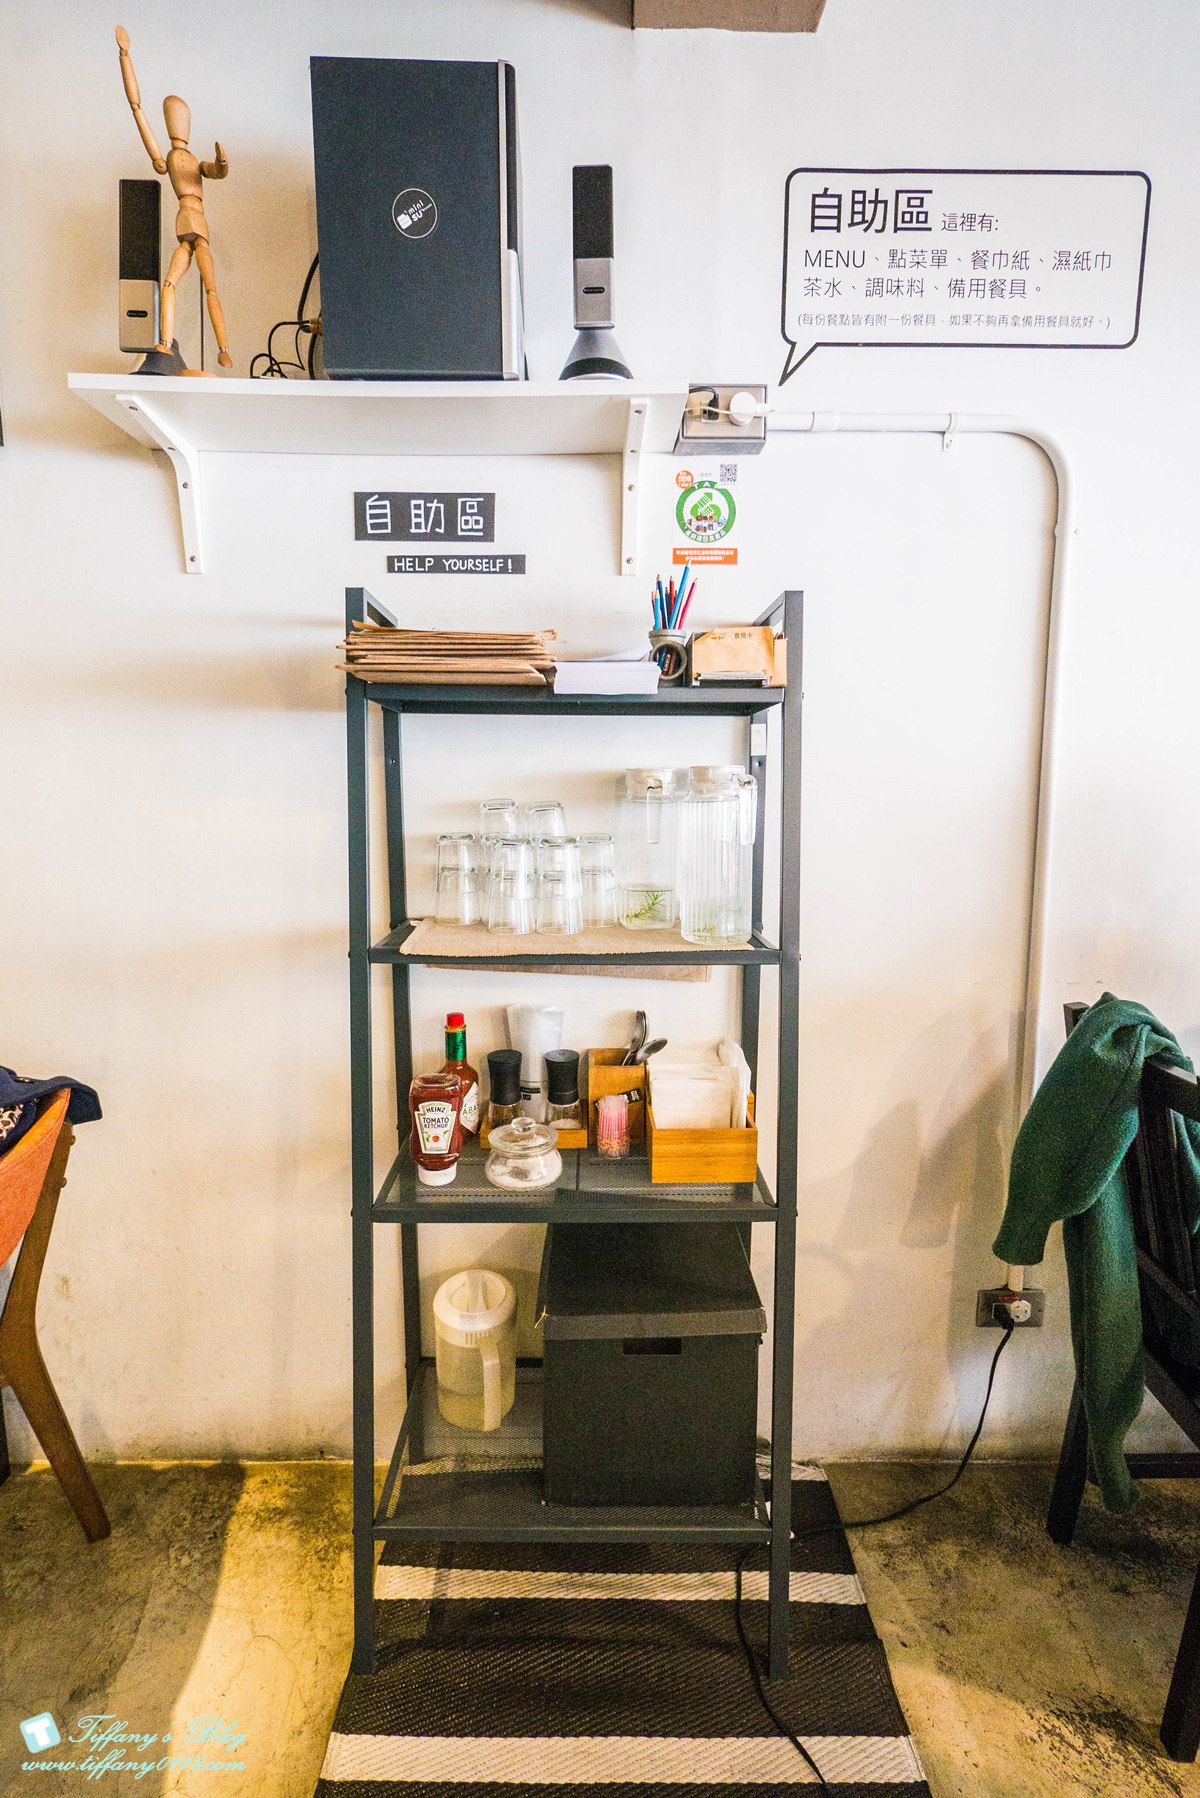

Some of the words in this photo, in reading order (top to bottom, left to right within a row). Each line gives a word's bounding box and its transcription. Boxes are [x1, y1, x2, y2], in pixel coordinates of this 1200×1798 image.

[810, 187, 933, 233] 自助區
[941, 212, 999, 233] 這裡有:
[803, 277, 1043, 299] 茶水、調味料、備用餐具。
[365, 494, 485, 536] 自助區
[394, 557, 434, 572] HELP
[442, 558, 513, 573] YOURSELF!
[425, 1106, 446, 1114] HEINZ
[422, 1116, 450, 1125] TOMATO
